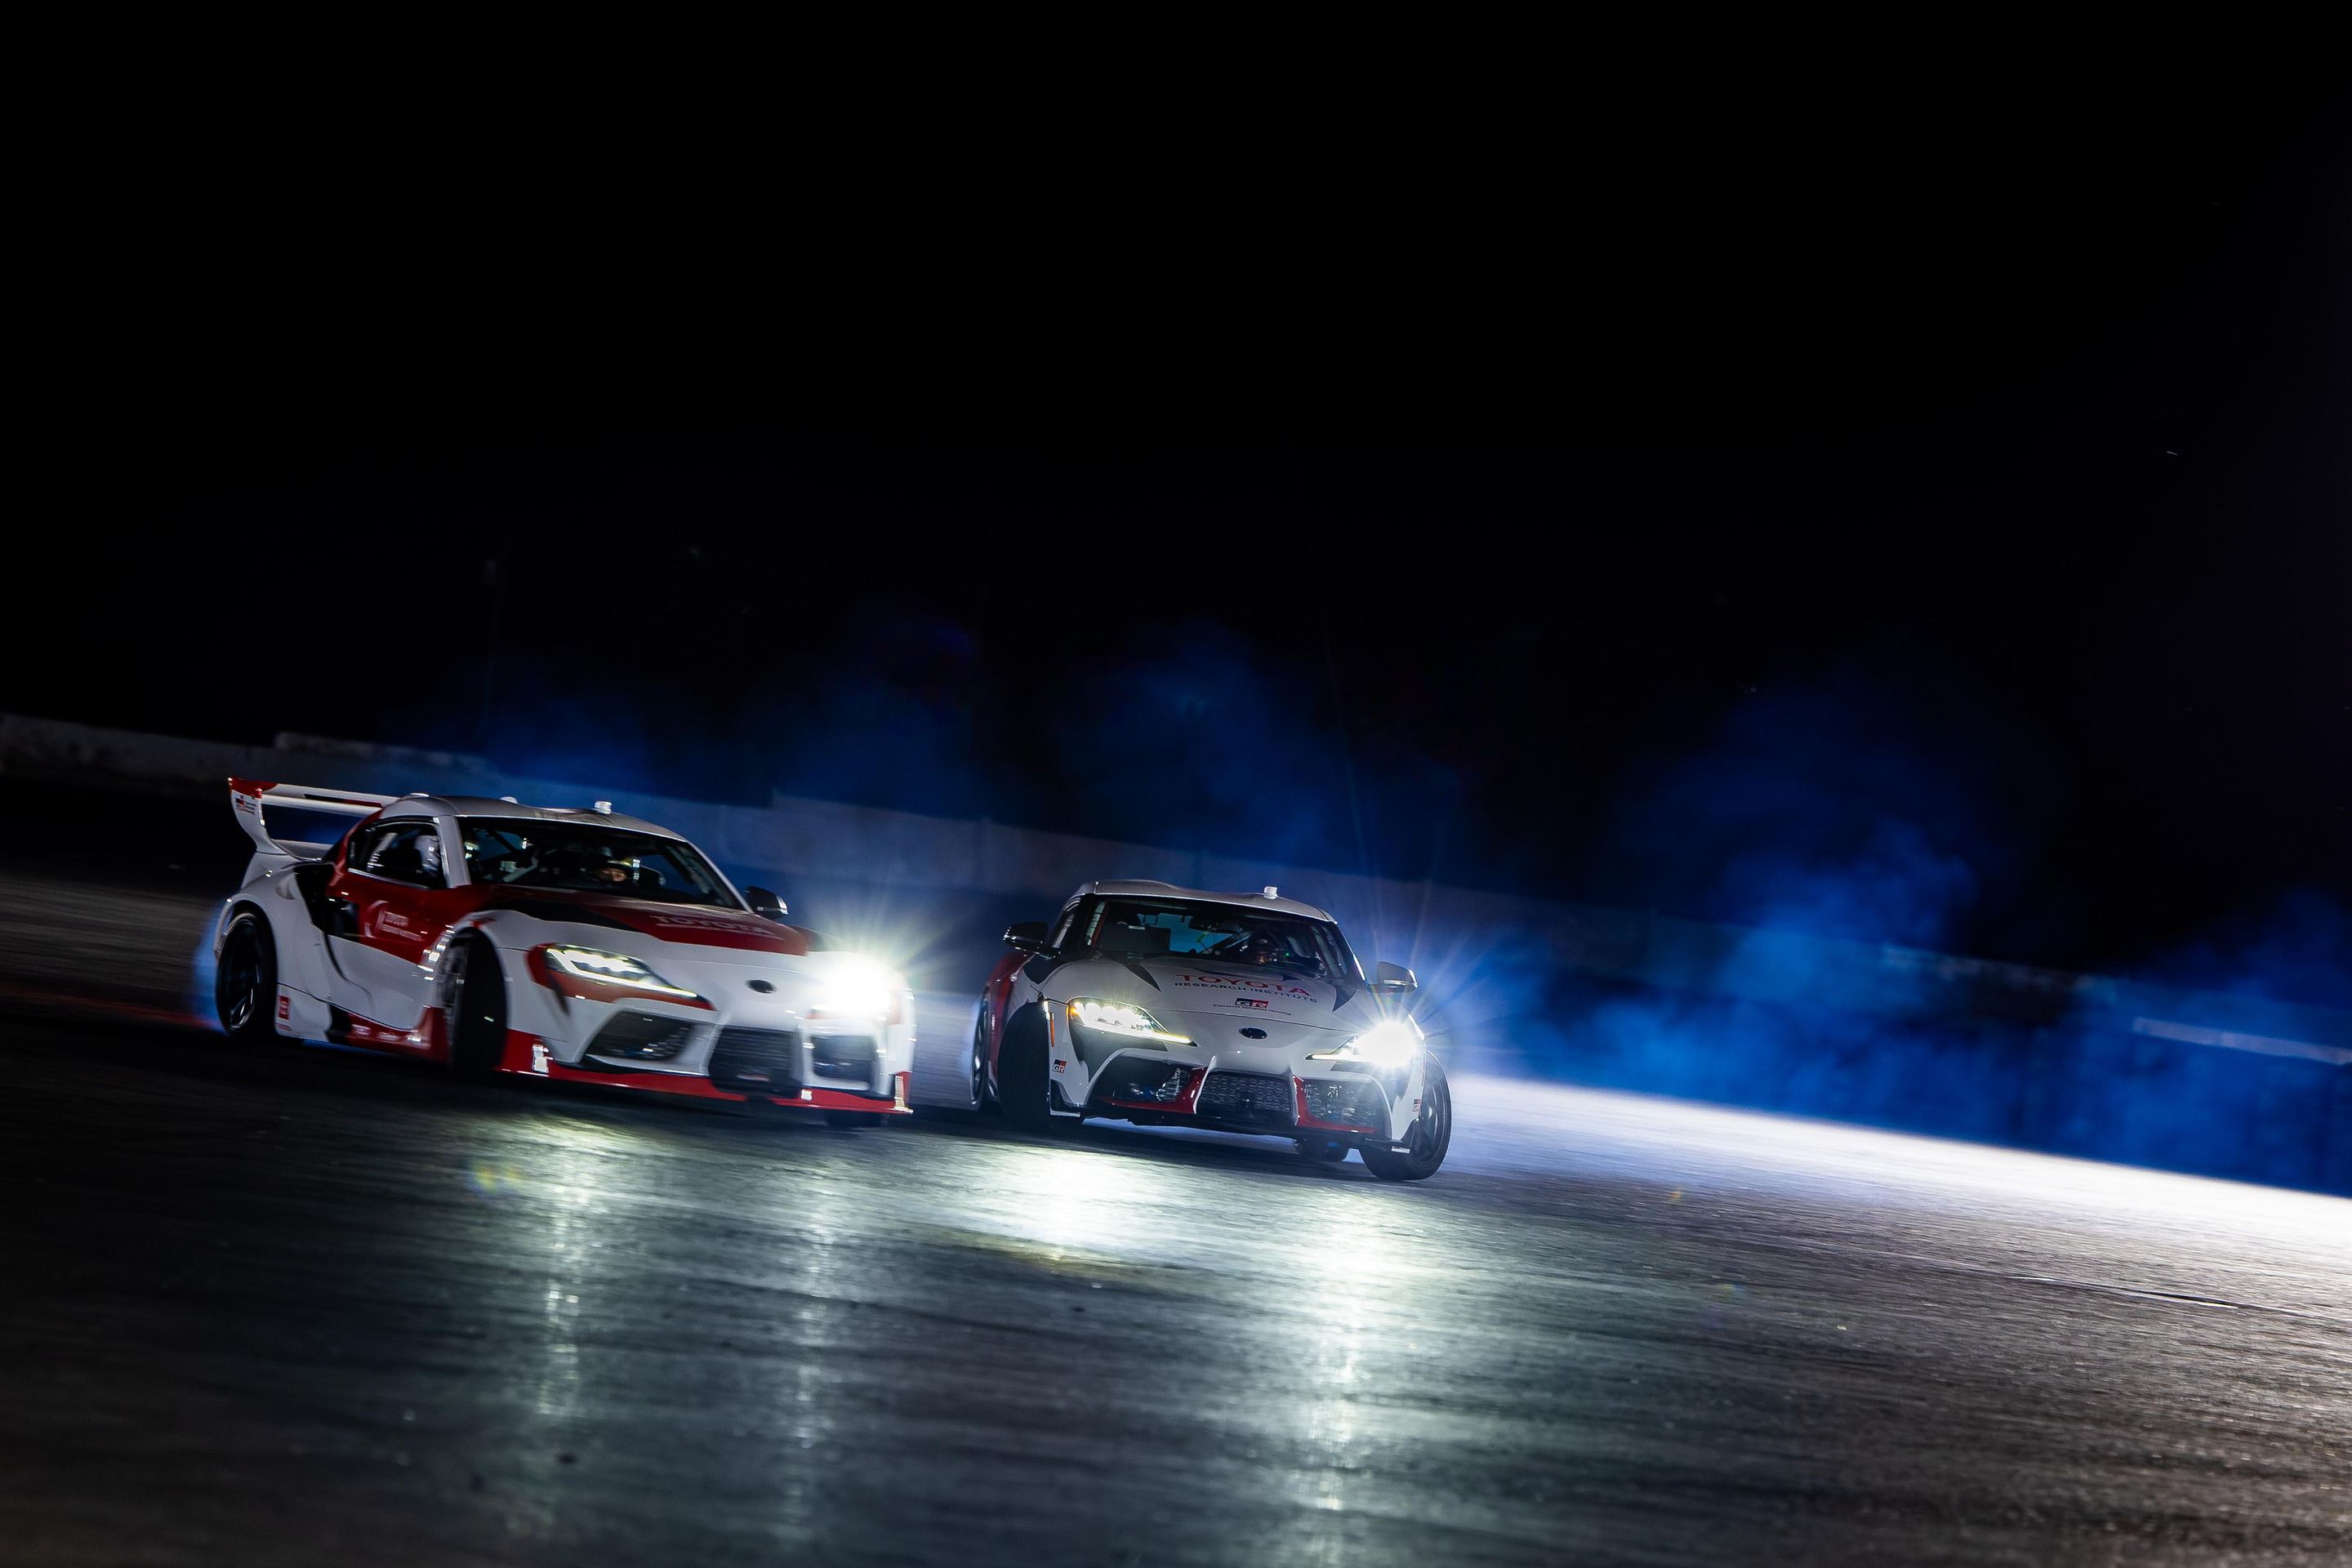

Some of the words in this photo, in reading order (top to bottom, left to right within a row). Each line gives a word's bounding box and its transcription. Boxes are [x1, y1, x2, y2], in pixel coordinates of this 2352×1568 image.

[1174, 982, 1246, 991] RESEARCH
[1250, 987, 1319, 1004] INSTITUTE
[1175, 974, 1312, 997] TOYOTA
